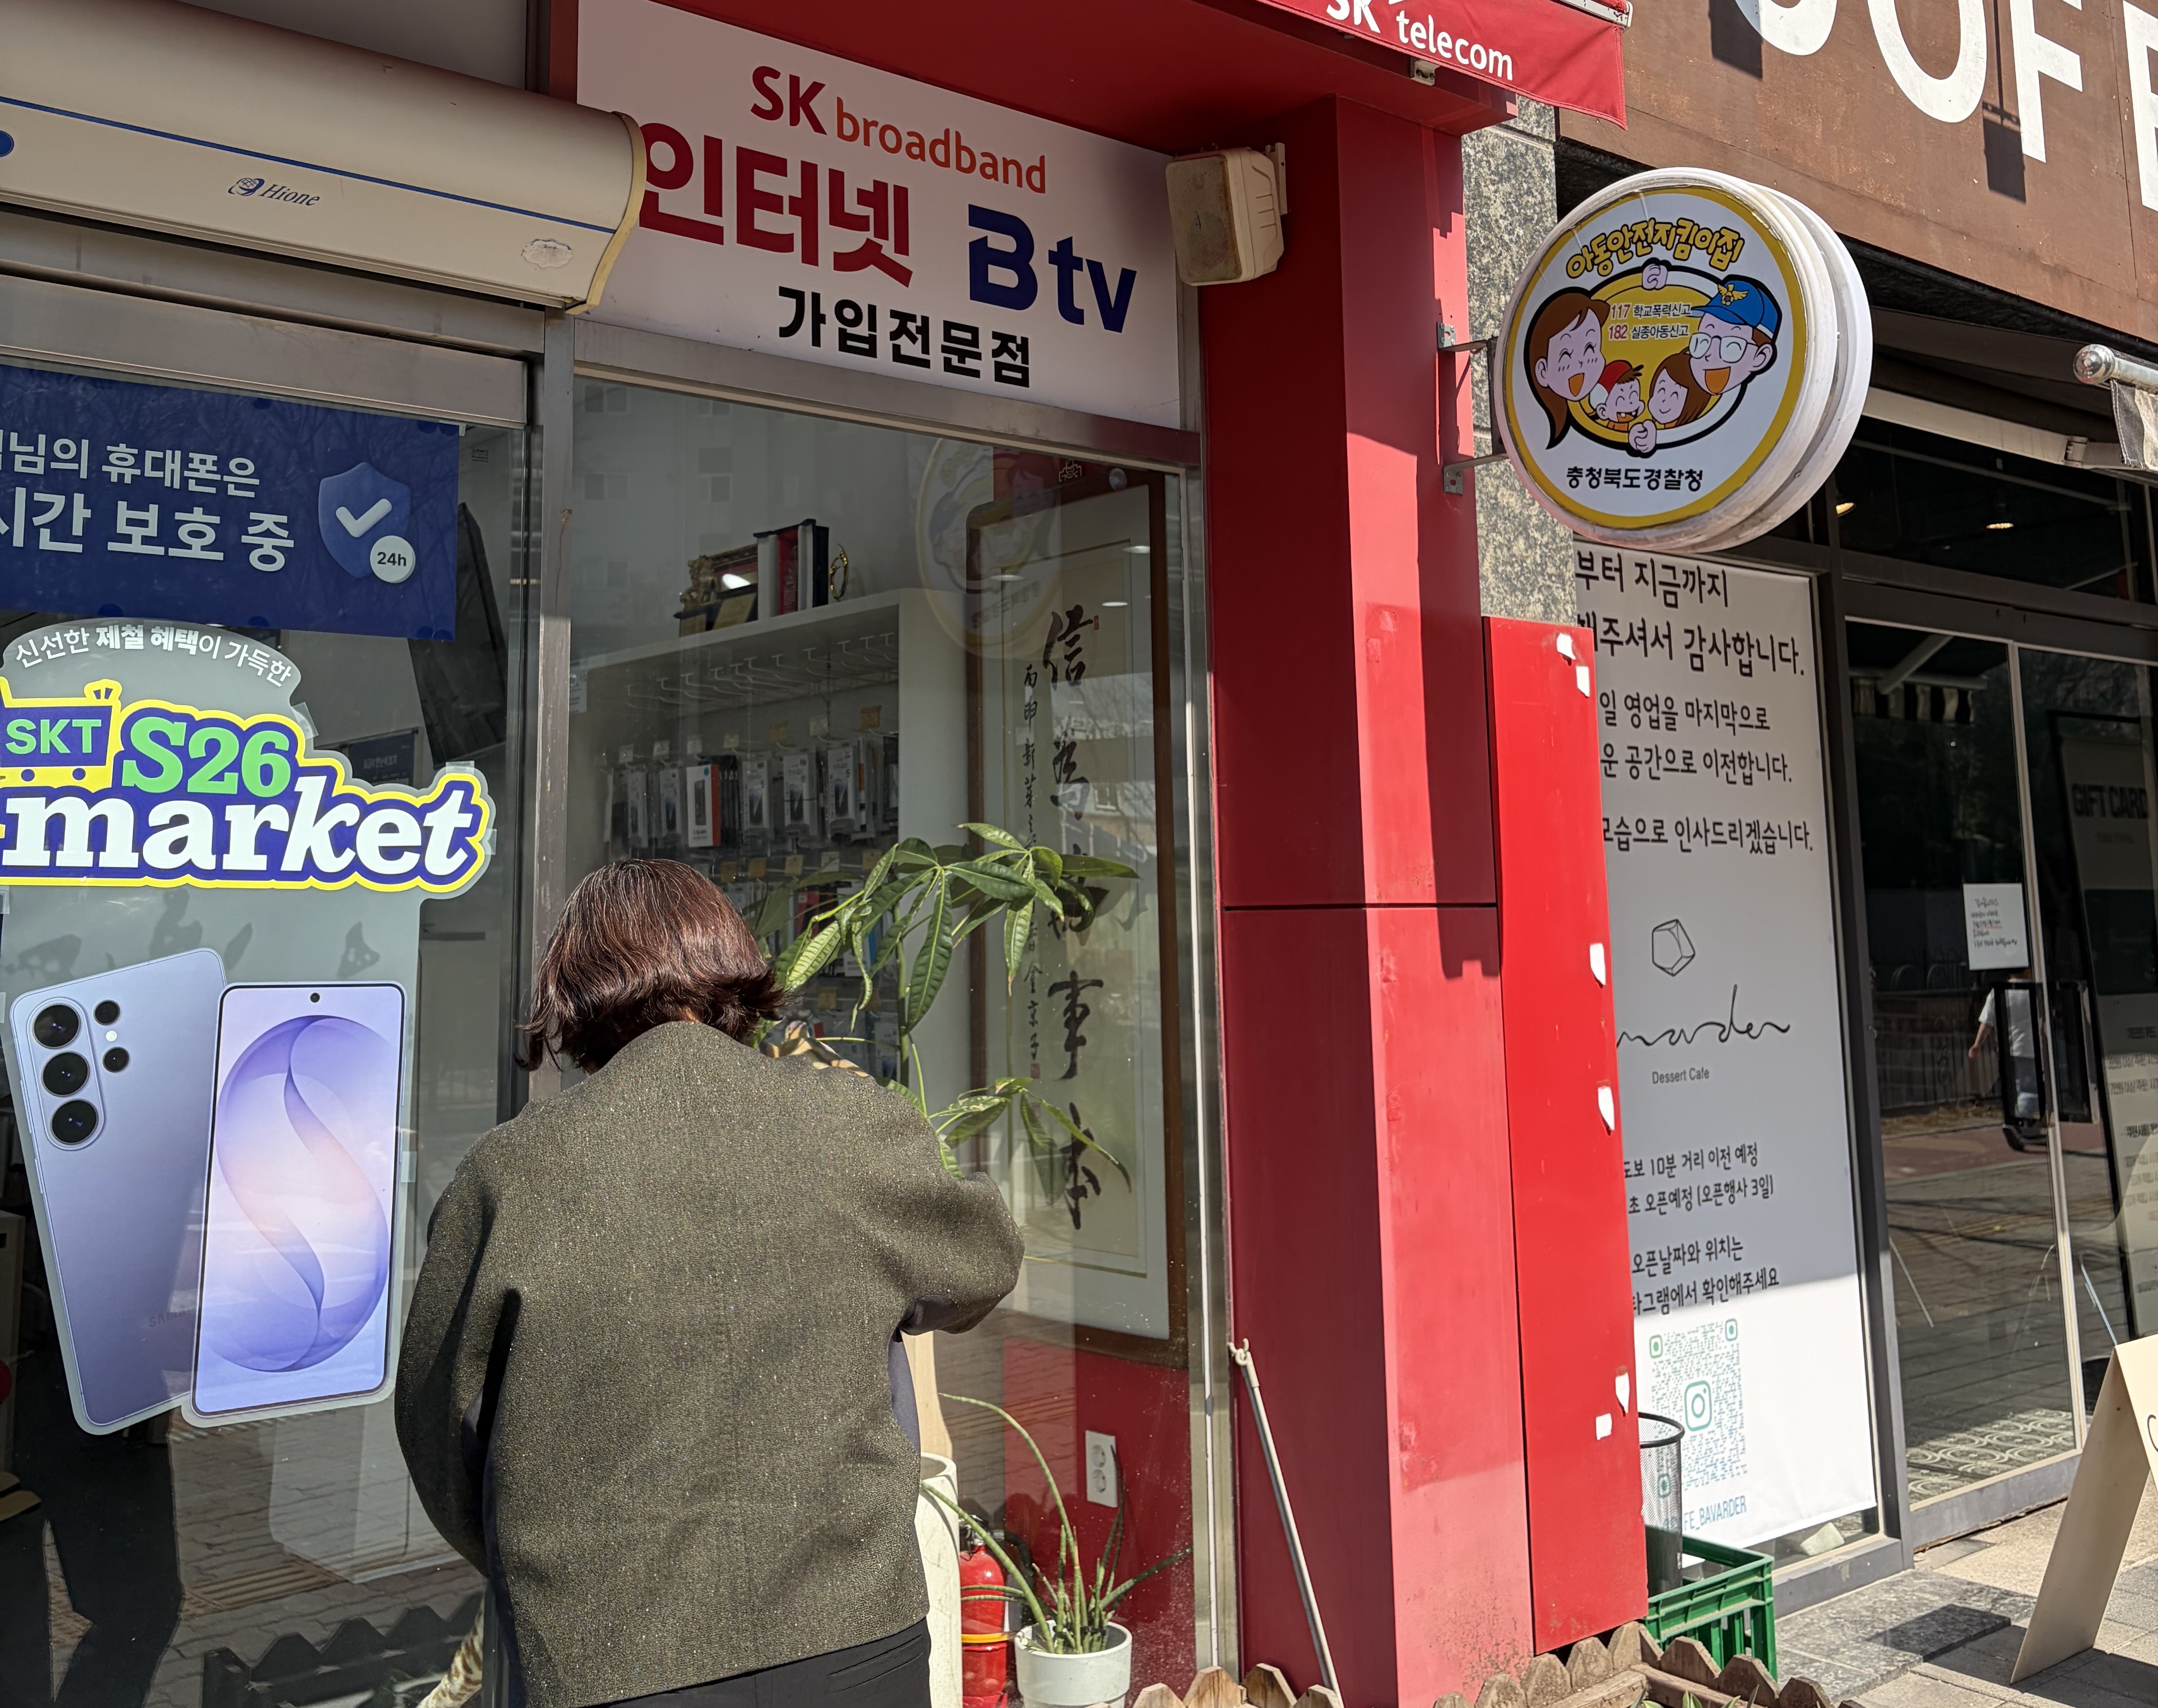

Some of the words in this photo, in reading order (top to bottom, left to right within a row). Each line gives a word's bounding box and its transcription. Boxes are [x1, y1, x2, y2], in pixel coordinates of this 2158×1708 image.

[1396, 10, 1513, 81] telecom
[751, 65, 827, 135] SK
[837, 97, 1046, 194] broadband
[260, 182, 320, 207] Hione
[638, 121, 914, 289] 인터넷
[1567, 217, 1744, 279] 아동안전지킴이집
[1609, 324, 1628, 340] 182
[1631, 324, 1689, 339] 실종아동신고
[1611, 304, 1631, 319] 117
[1634, 303, 1692, 318] 학교폭력신고
[778, 286, 1031, 388] 가입전문점
[0, 429, 89, 479] 님의
[101, 442, 260, 498] 휴대폰은
[1566, 466, 1703, 492] 충청북도경찰청
[107, 500, 225, 561] 보호
[241, 511, 295, 572] 중
[376, 551, 408, 567] 24h
[1575, 550, 1624, 593] 부터
[1634, 557, 1728, 608] 지금까지
[16, 627, 90, 669] 신선한
[95, 625, 145, 651] 제철
[150, 626, 221, 660] 혜택이
[224, 641, 292, 688] 가득한
[1684, 624, 1805, 678] 감사합니다.
[1599, 689, 1617, 727] 일
[1624, 692, 1678, 732] 영업을
[1684, 697, 1771, 736] 마지막으로
[6, 718, 102, 754] SKT
[121, 716, 291, 798] S26
[1600, 742, 1618, 778] 운
[1625, 743, 1697, 781] 공간으로
[1703, 747, 1792, 786] 이전합니다.
[2, 775, 473, 876] market
[1674, 815, 1813, 855] 인사드리겠습니다.
[1652, 1070, 1687, 1084] Dessert
[1689, 1066, 1710, 1081] Cafe
[1651, 1153, 1677, 1179] 10분
[1681, 1148, 1704, 1171] 거리
[1708, 1145, 1731, 1171] 이전
[1734, 1142, 1758, 1167] 예정
[1628, 1195, 1641, 1214] 초
[1644, 1185, 1693, 1216] 오픈예정
[1705, 1235, 1743, 1262] 위치는
[1702, 1267, 1780, 1307] 확인해주세요
